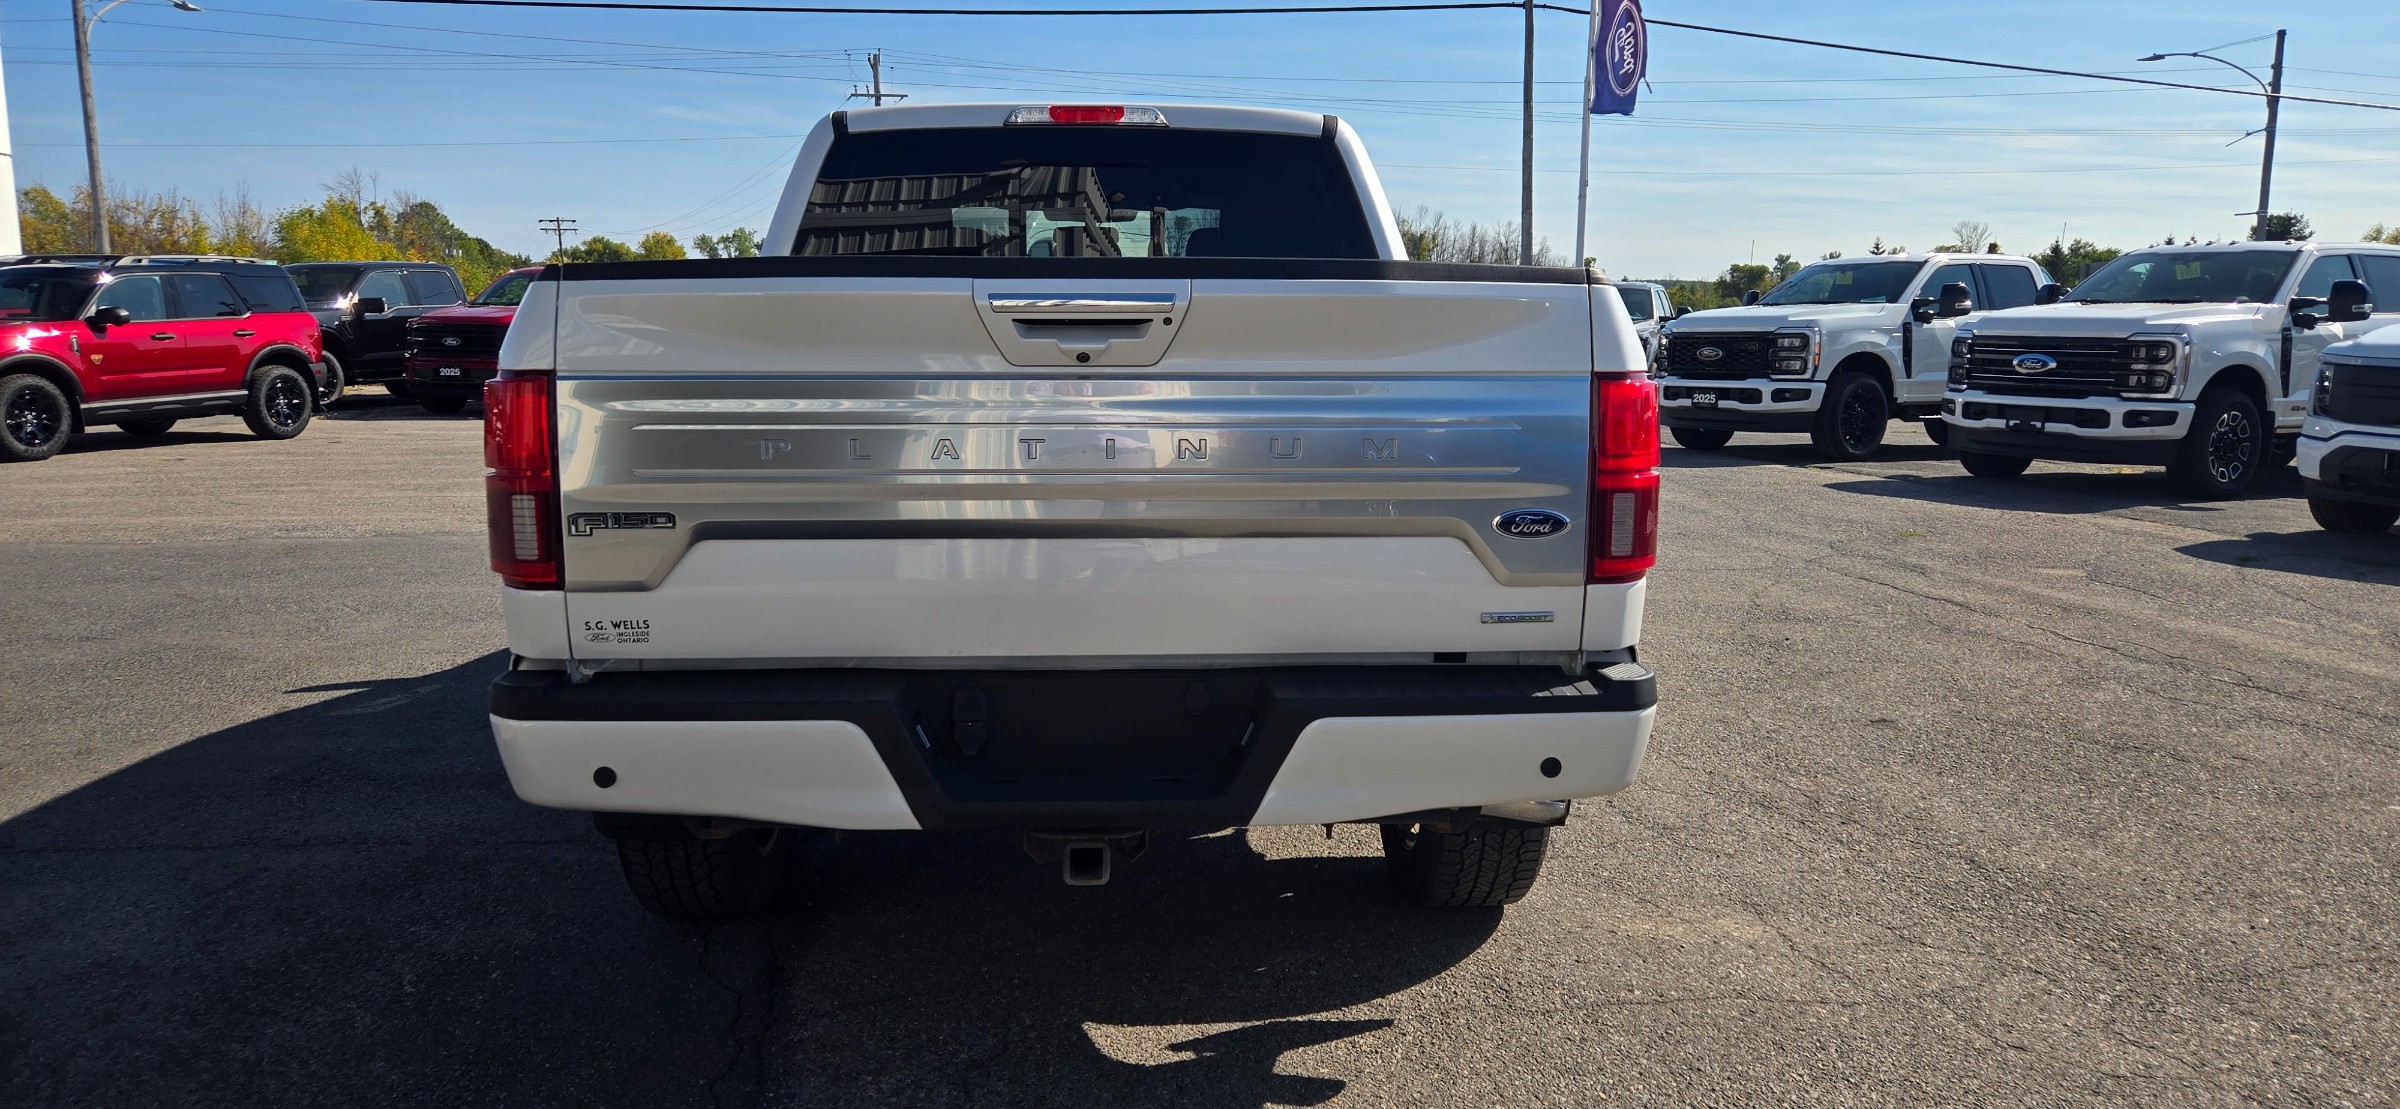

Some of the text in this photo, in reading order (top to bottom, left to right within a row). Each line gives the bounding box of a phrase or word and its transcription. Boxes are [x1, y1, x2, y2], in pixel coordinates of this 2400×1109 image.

[440, 368, 460, 376] 2025
[1693, 394, 1716, 403] 2025
[761, 438, 1397, 460] PLATINUM
[1511, 515, 1554, 533] Ford
[584, 619, 650, 631] S.G. WELLS
